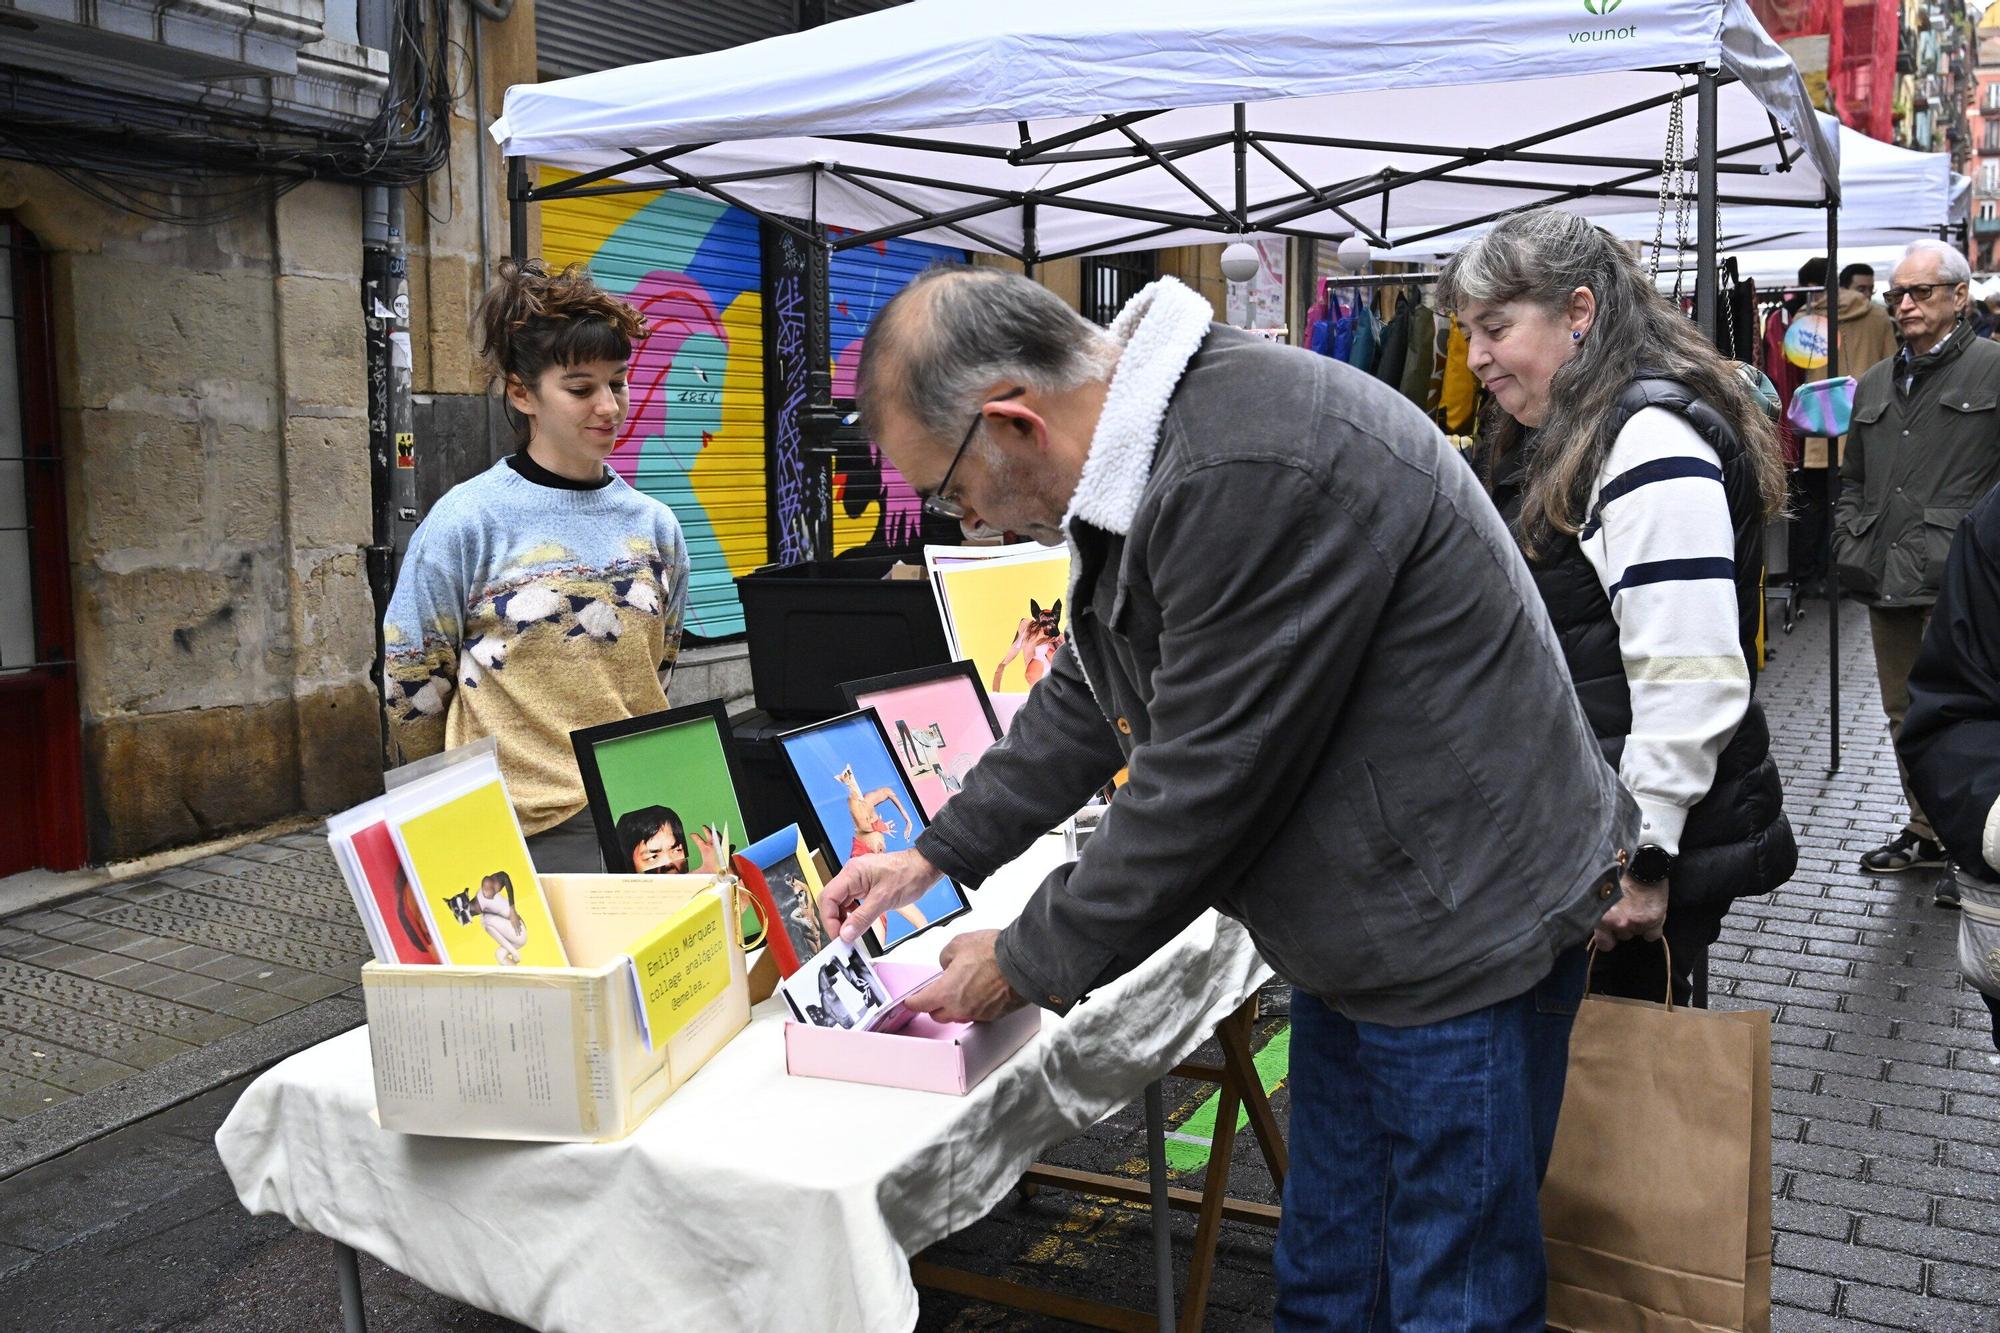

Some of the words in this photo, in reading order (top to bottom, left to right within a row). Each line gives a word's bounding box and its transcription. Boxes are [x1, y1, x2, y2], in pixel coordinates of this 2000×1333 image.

[1568, 24, 1637, 44] vounot
[647, 947, 680, 977] Emilia
[682, 920, 717, 951] Márquez
[649, 971, 682, 1003] collage
[685, 940, 723, 975] analógico
